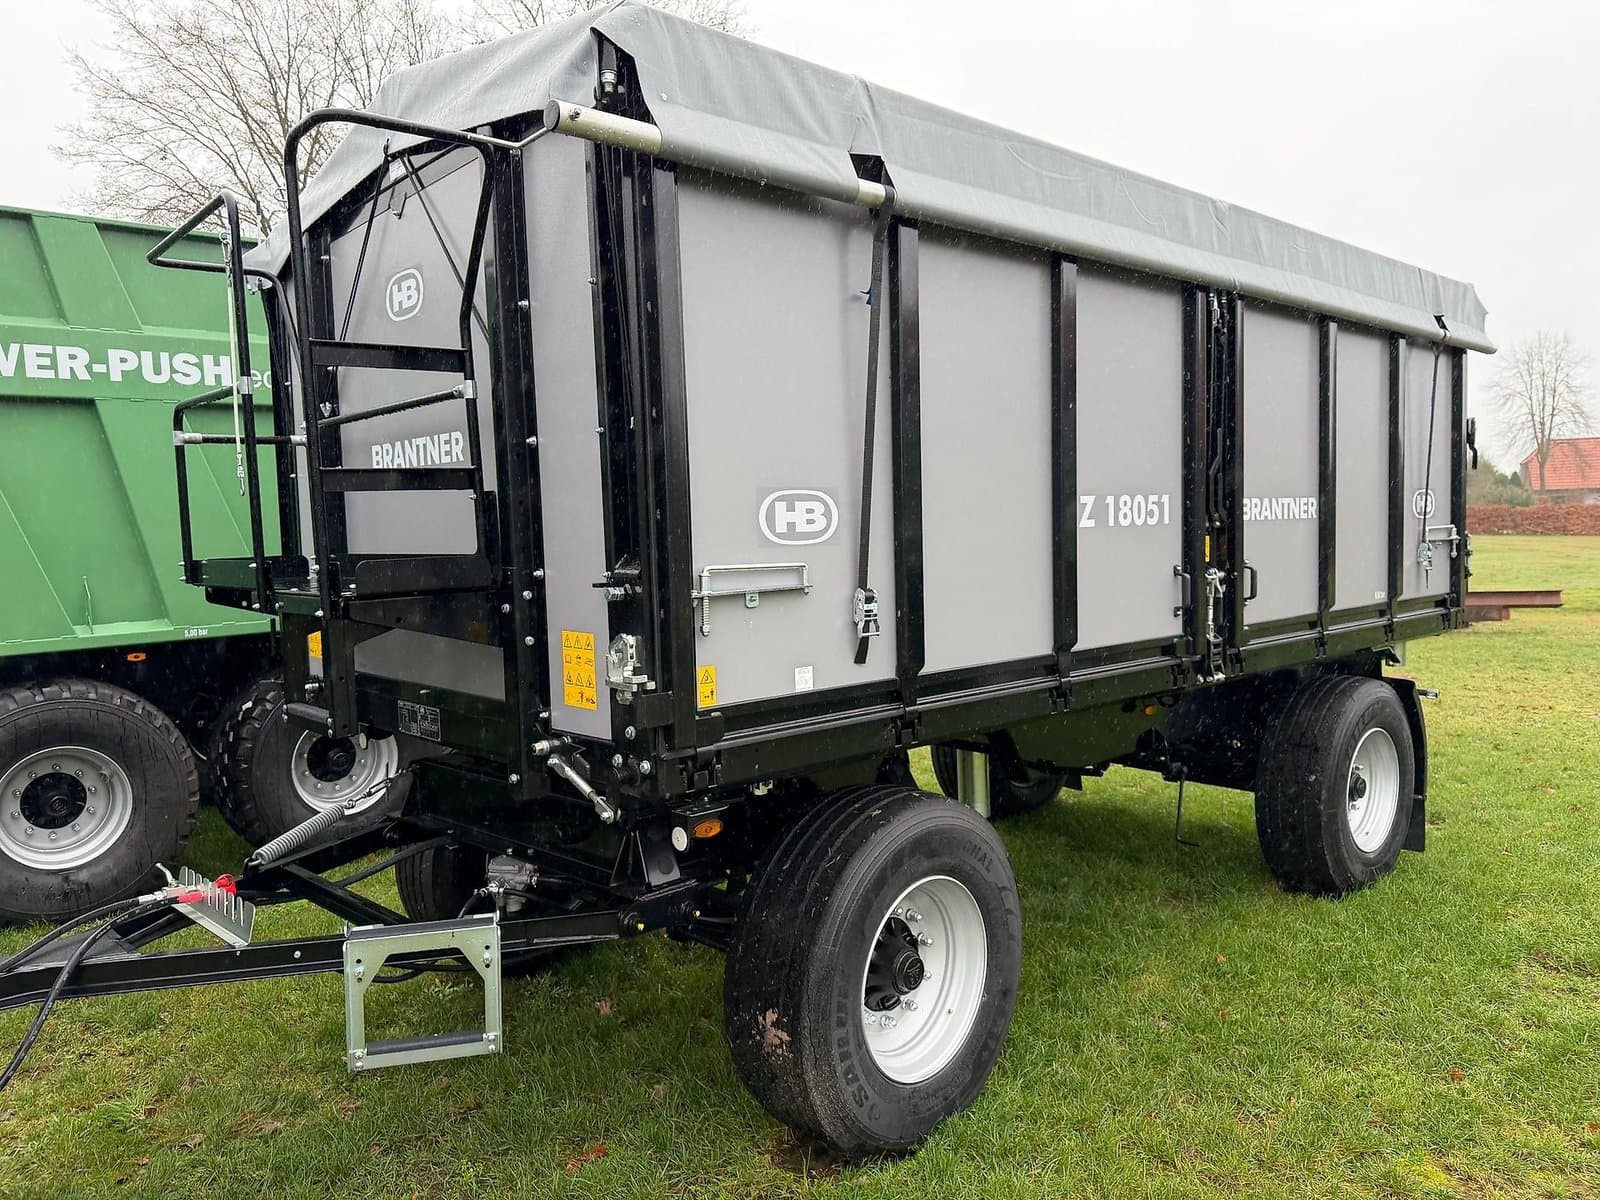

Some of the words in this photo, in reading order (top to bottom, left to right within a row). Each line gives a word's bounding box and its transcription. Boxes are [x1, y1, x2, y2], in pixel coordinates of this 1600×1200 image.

[371, 431, 465, 468] BRANTNER
[1079, 495, 1096, 528] Z
[1105, 494, 1170, 527] 18051
[1243, 497, 1317, 521] BRANTNER
